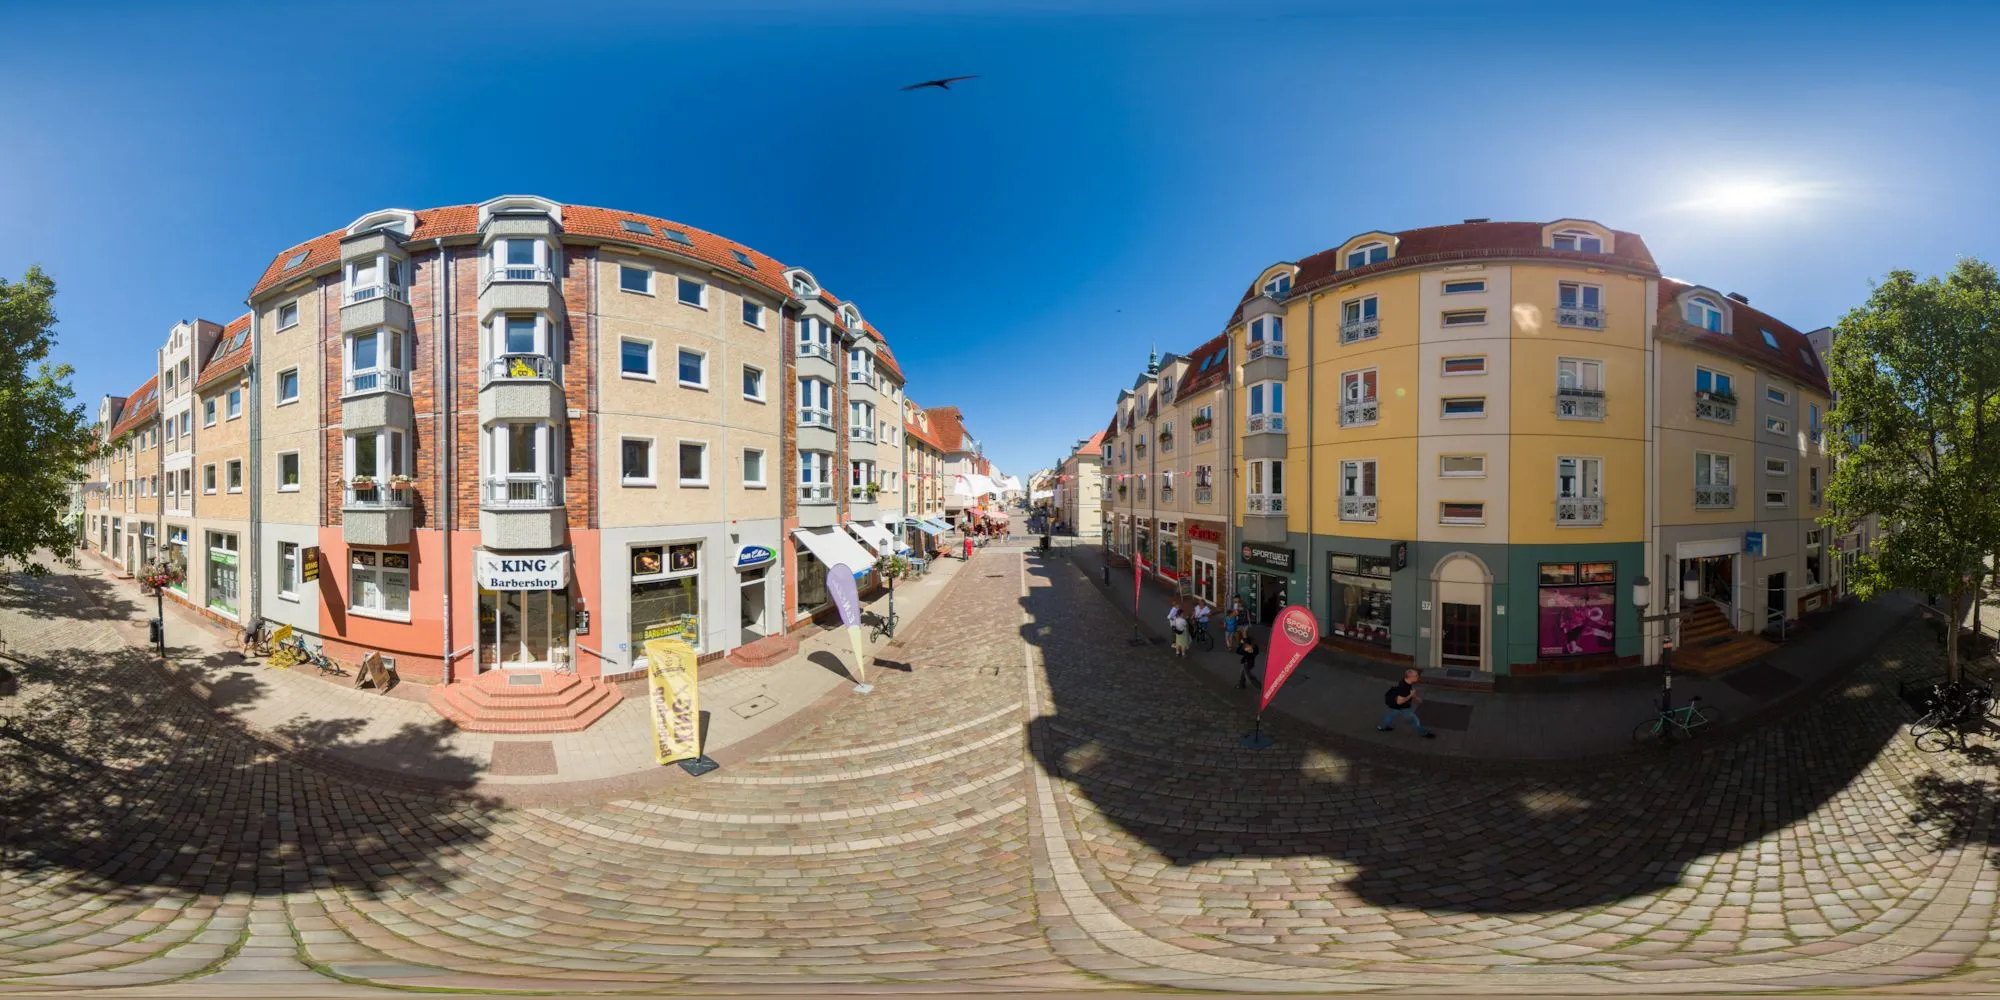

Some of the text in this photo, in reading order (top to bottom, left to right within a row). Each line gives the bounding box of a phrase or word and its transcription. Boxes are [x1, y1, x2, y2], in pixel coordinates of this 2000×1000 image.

[1252, 549, 1289, 562] SPORTWELT
[501, 559, 547, 572] KING
[491, 578, 557, 588] Barbershop
[1286, 617, 1312, 633] SPORT
[1287, 626, 1309, 638] 2000
